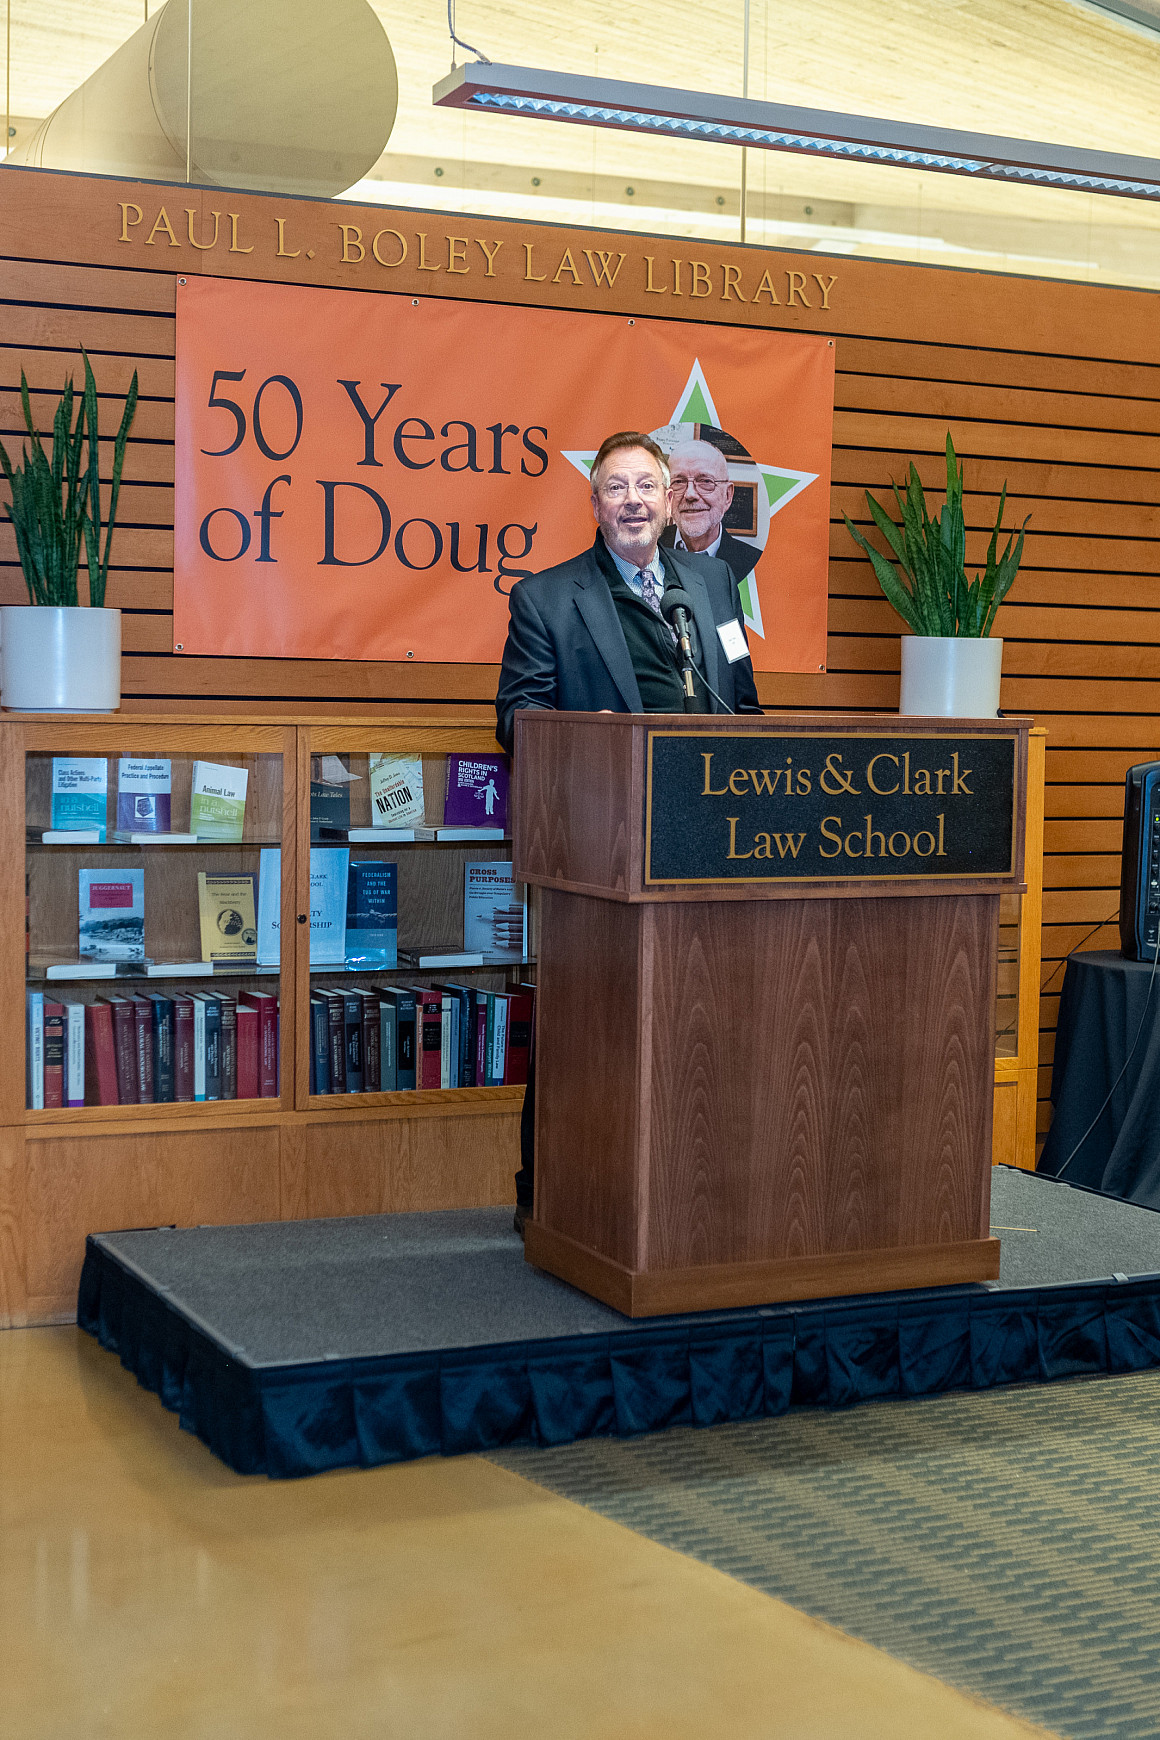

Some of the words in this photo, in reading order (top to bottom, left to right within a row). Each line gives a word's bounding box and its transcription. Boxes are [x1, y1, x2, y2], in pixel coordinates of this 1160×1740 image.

[117, 202, 254, 254] PAUL
[274, 218, 316, 260] L.
[338, 224, 504, 278] BOLEY
[522, 243, 627, 289] LAW
[644, 256, 838, 310] LIBRARY
[200, 368, 304, 461] 50
[336, 378, 549, 478] Years
[199, 474, 292, 563] of
[315, 479, 539, 597] Doug
[458, 760, 499, 773] CHILDREN'S
[458, 766, 480, 776] RIGHTS
[700, 752, 812, 796] Lewis
[819, 752, 862, 796] &
[866, 750, 975, 796] Clark
[458, 772, 486, 782] SCOTLAND
[202, 785, 222, 796] Animal
[224, 788, 236, 798] Law
[375, 786, 413, 814] NATION
[200, 804, 238, 816] nutshell
[725, 816, 807, 860] Law
[818, 812, 948, 859] School
[469, 876, 516, 884] PURPOSES
